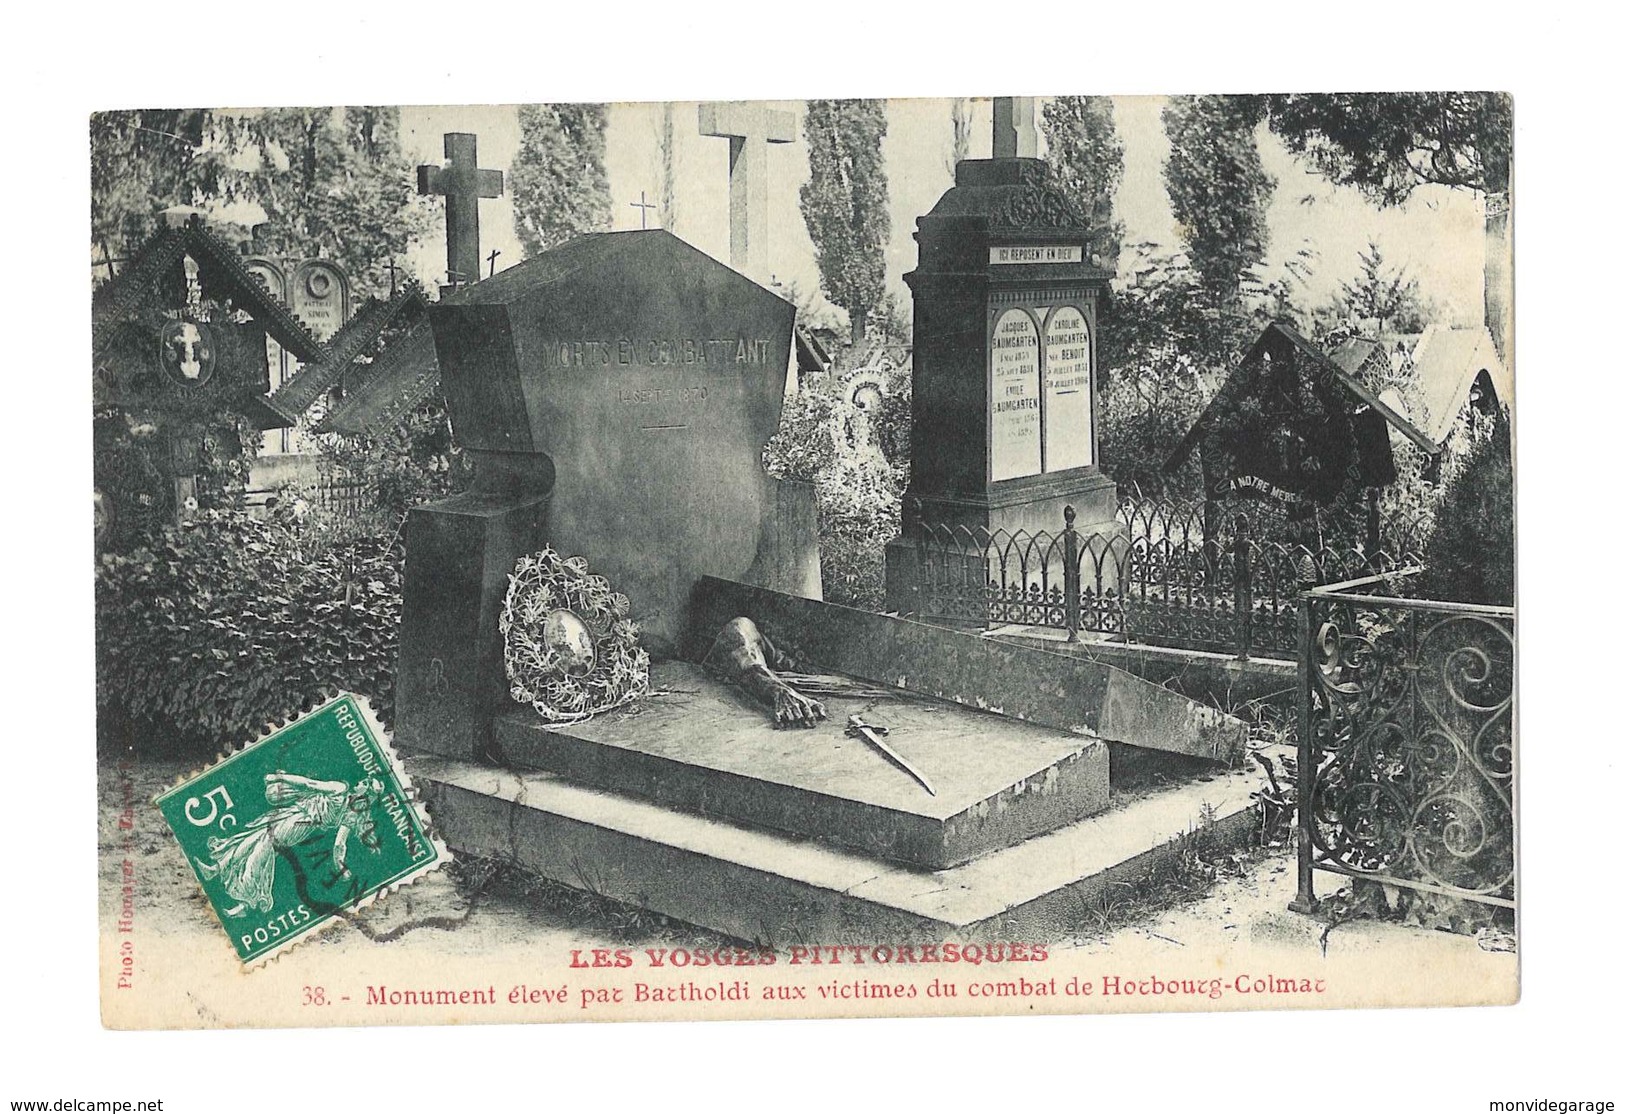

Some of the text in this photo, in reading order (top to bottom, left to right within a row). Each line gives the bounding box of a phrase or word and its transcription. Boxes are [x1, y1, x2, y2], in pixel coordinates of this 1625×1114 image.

[1011, 249, 1044, 260] REPOSENT
[1047, 248, 1056, 260] EN
[1058, 248, 1072, 260] DIEU
[1001, 321, 1028, 334] JACQUES
[1054, 319, 1080, 330] CAROLINE
[543, 337, 771, 367] MORTS EN COMBATTANT
[992, 336, 1037, 349] BAUMGARTEN
[1046, 332, 1088, 346] BAUMGARTEN
[1061, 348, 1085, 360] BENOIT
[1230, 475, 1296, 503] A NOTRE MERE
[334, 703, 383, 779] REPUBLIQUE
[241, 904, 311, 952] POSTES
[116, 941, 134, 990] Photo
[569, 941, 1049, 968] LES VOSGES PITTORESQUES
[302, 985, 332, 1006] 38.
[366, 985, 497, 1006] Monument
[508, 983, 569, 1005] élevé
[581, 987, 624, 1008] par
[635, 980, 751, 1002] Bartholdi
[762, 984, 807, 1001] aux
[818, 979, 918, 999] victimes
[927, 978, 958, 998] du
[968, 977, 1057, 997] combat
[1065, 977, 1094, 996] de
[1102, 974, 1327, 999] Horbourg-Colmar
